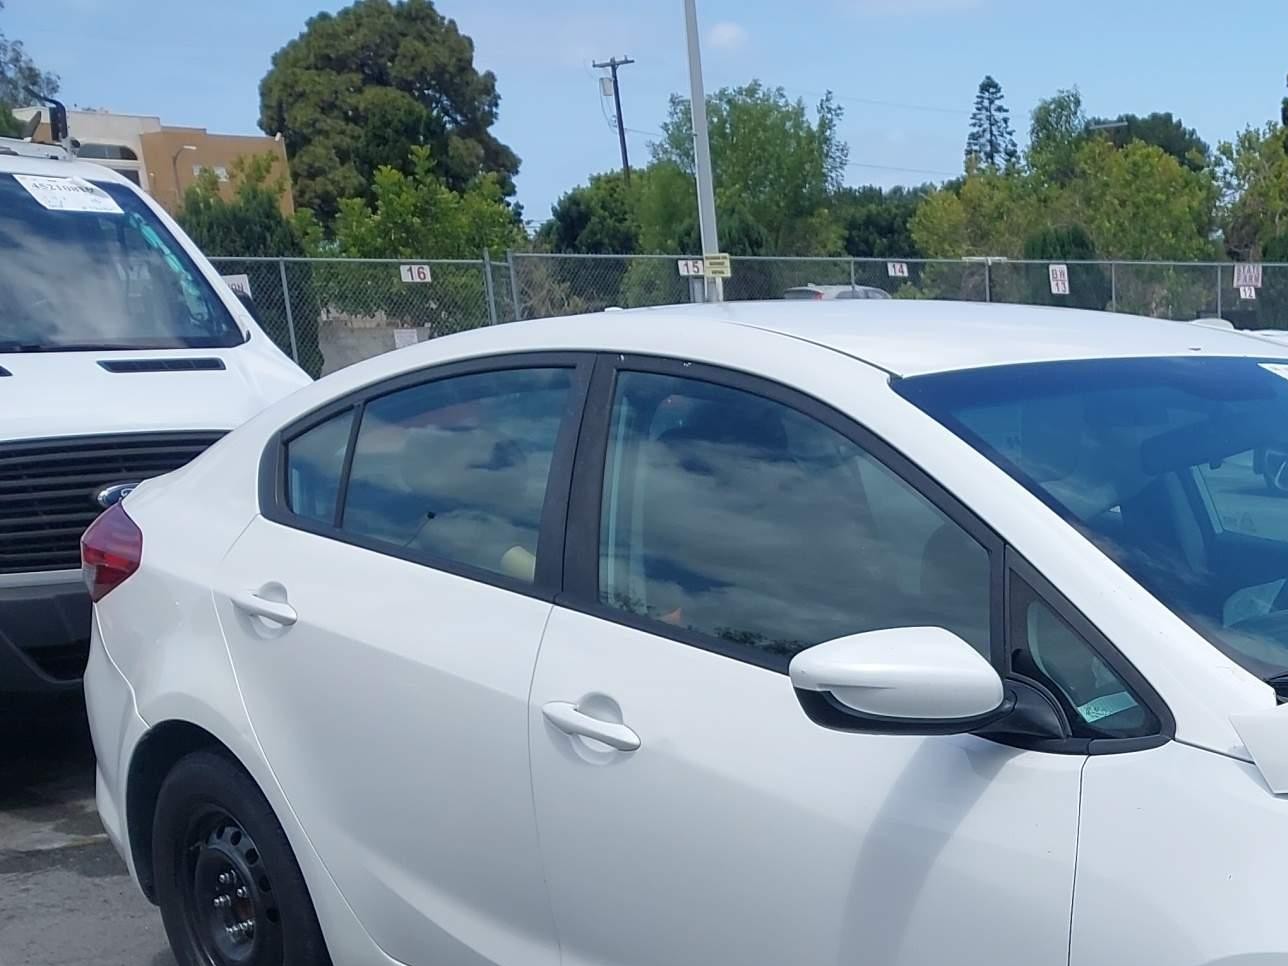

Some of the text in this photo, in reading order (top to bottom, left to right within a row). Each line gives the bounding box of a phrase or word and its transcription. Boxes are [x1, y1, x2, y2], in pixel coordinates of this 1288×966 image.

[683, 260, 700, 274] 15
[892, 263, 904, 275] 14
[407, 266, 426, 281] 16
[1055, 280, 1067, 292] 13
[1243, 286, 1254, 298] 12
